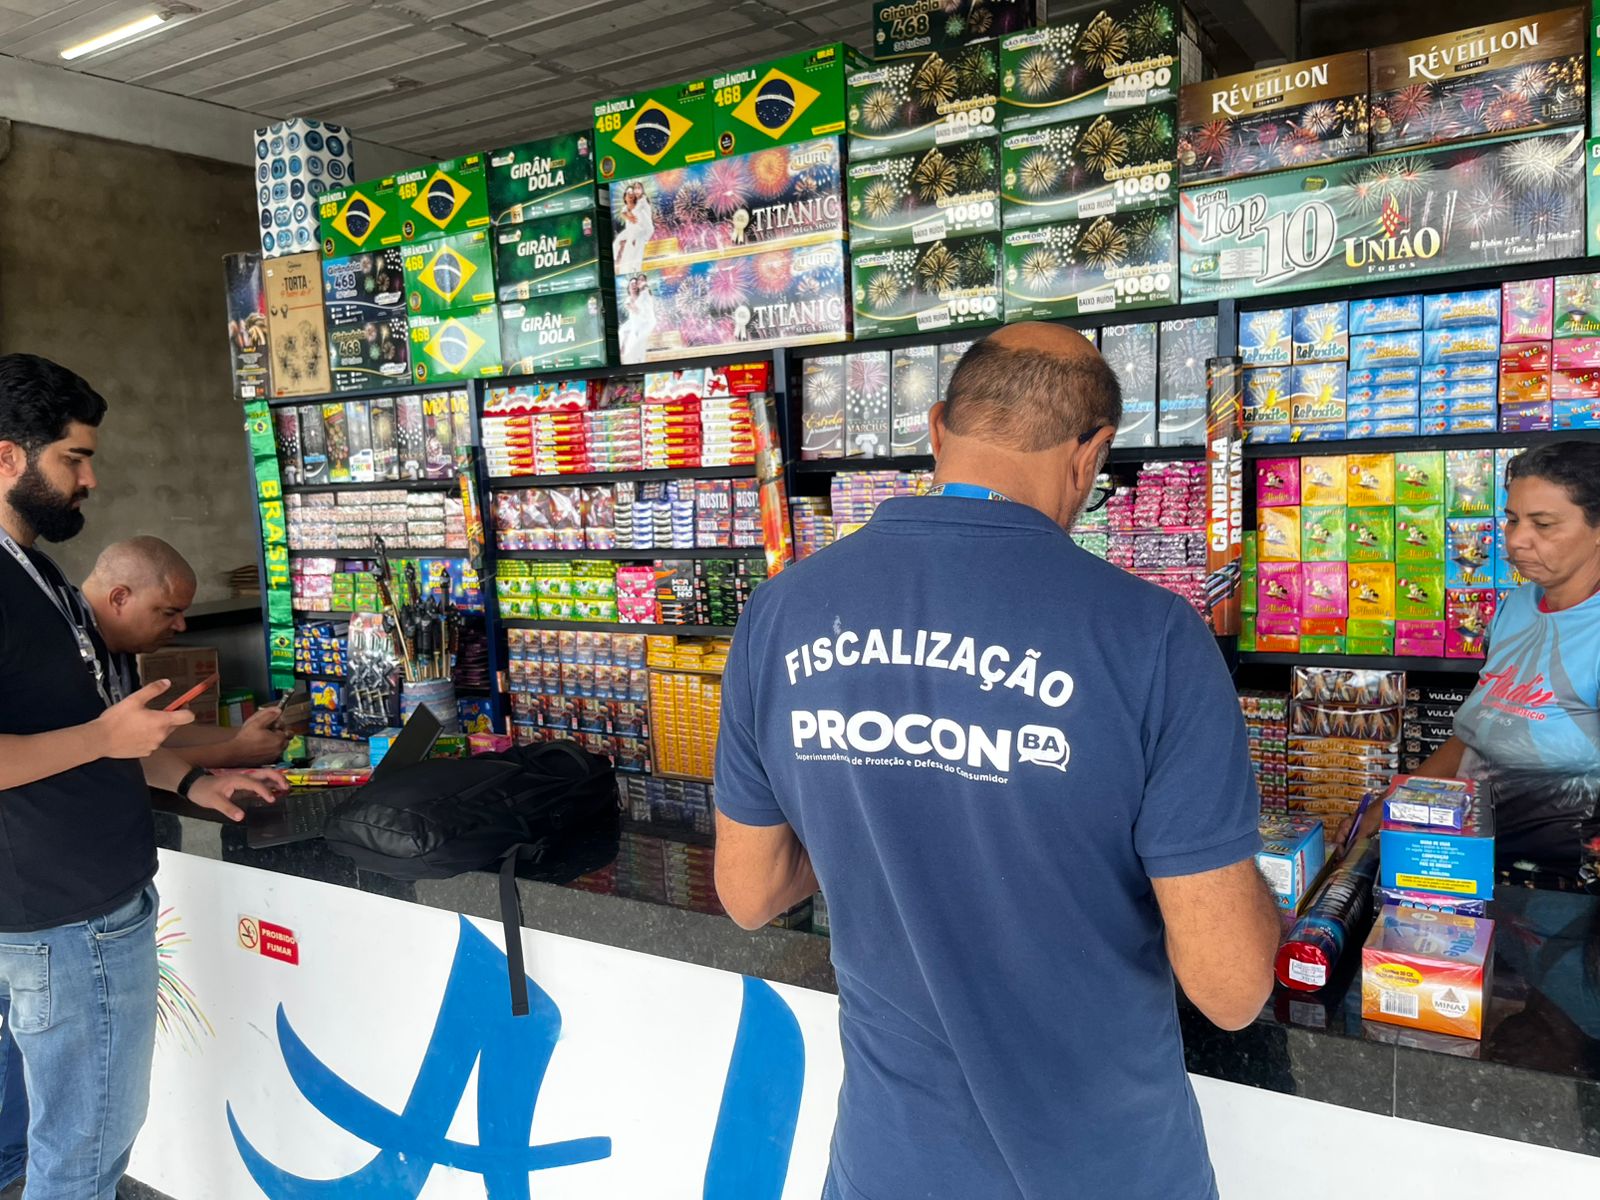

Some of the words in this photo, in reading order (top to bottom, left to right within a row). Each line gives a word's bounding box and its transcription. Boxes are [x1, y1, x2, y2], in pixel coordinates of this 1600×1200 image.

[880, 1, 939, 21] Girândola
[891, 14, 929, 39] 468
[1020, 33, 1046, 43] PEDRO
[1408, 23, 1538, 79] RÉVEILLON
[1114, 67, 1171, 90] 1080
[713, 84, 742, 107] 468
[1109, 90, 1126, 100] BAIXO
[1212, 63, 1328, 115] RÉVEILLON
[595, 112, 622, 133] 468
[946, 106, 995, 127] 1080
[1021, 133, 1046, 143] PEDRO
[510, 156, 551, 180] GIRÂN
[528, 170, 565, 192] DOLA
[1114, 173, 1171, 197] 1080
[398, 182, 418, 200] 468
[320, 202, 338, 219] 468
[752, 195, 838, 230] TITANIC
[945, 201, 994, 223] 1080
[1079, 202, 1096, 213] BAIXO
[1200, 195, 1266, 242] Top
[1022, 231, 1047, 240] PEDRO
[1254, 201, 1334, 283] 10
[517, 235, 557, 257] GIRÂN
[1344, 226, 1440, 267] UNIÃO
[405, 255, 424, 271] 468
[535, 249, 570, 270] DOLA
[1368, 263, 1416, 273] Fogos
[284, 275, 308, 291] TORTA
[334, 273, 356, 289] 468
[1114, 273, 1171, 296] 1080
[948, 297, 996, 316] 1080
[1078, 296, 1095, 306] BAIXO
[521, 311, 562, 333] GIRÂN
[753, 297, 841, 329] TITANIC
[411, 327, 430, 343] 468
[538, 327, 575, 345] DOLA
[339, 340, 361, 357] 468
[1518, 345, 1548, 358] VULCO
[1294, 404, 1342, 419] RePuxito
[848, 423, 888, 432] MARCIUS
[699, 492, 728, 509] ROSITA
[736, 491, 759, 508] ROSI
[1211, 436, 1228, 552] CANDELA
[1230, 438, 1242, 545] ROMANA
[260, 480, 287, 590] BRASIL
[1449, 521, 1493, 532] VULCÃO
[1450, 591, 1492, 602] VULCÃO
[785, 629, 1074, 707] FISCALIZAÇÃO
[1427, 708, 1456, 718] VULCÃ
[791, 710, 1012, 772] PROCON
[1431, 727, 1454, 736] VULC
[1022, 733, 1060, 753] BA
[851, 757, 863, 765] de
[865, 757, 905, 767] Proteção
[906, 759, 912, 767] e
[914, 759, 943, 769] Defesa
[944, 764, 955, 773] do
[956, 766, 1009, 784] Consumidor
[262, 928, 296, 945] PROIBIDO
[267, 942, 292, 957] FUMAR
[1435, 1001, 1466, 1012] MINAS
